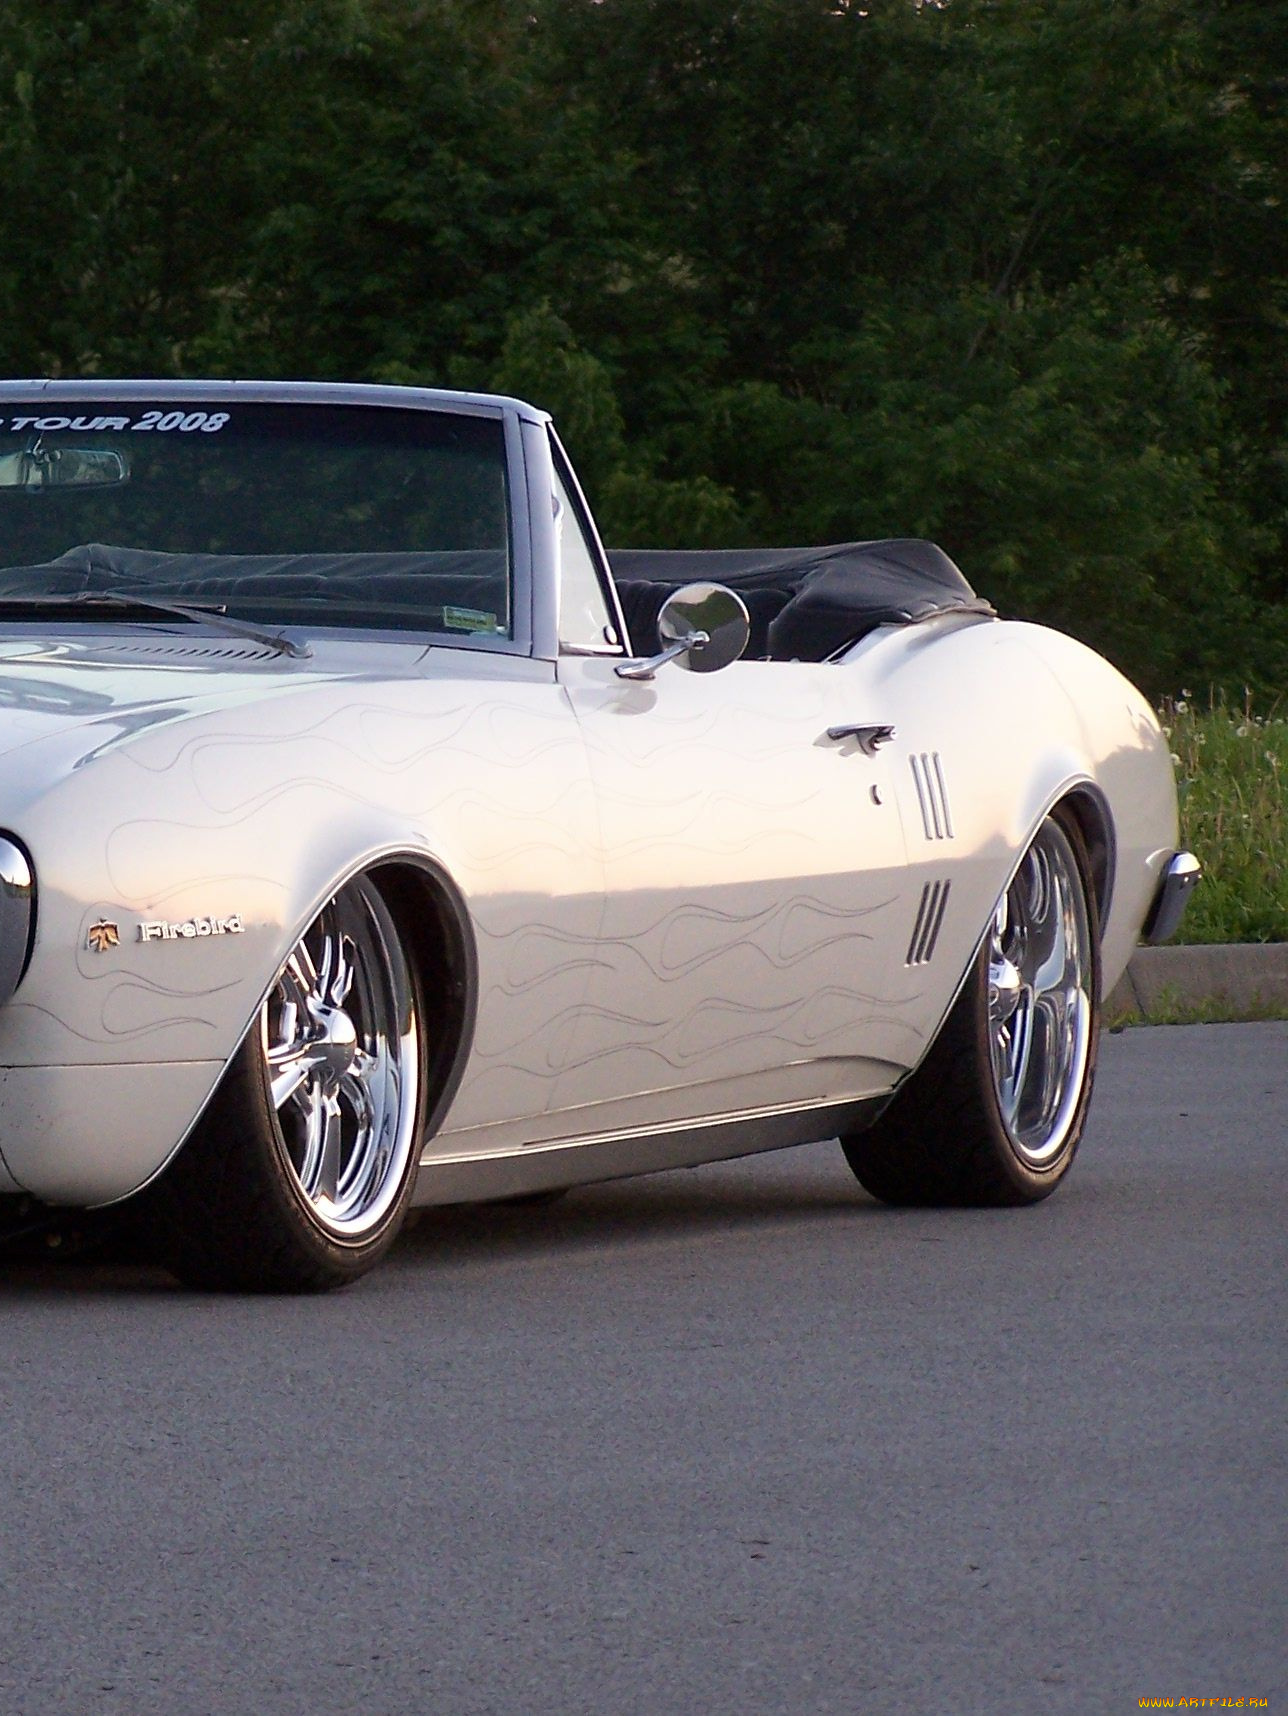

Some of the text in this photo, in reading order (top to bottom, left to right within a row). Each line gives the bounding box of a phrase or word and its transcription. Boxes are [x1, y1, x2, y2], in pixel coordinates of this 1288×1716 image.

[11, 415, 131, 431] TOUR
[131, 411, 231, 433] 2008
[136, 913, 245, 942] Firebird
